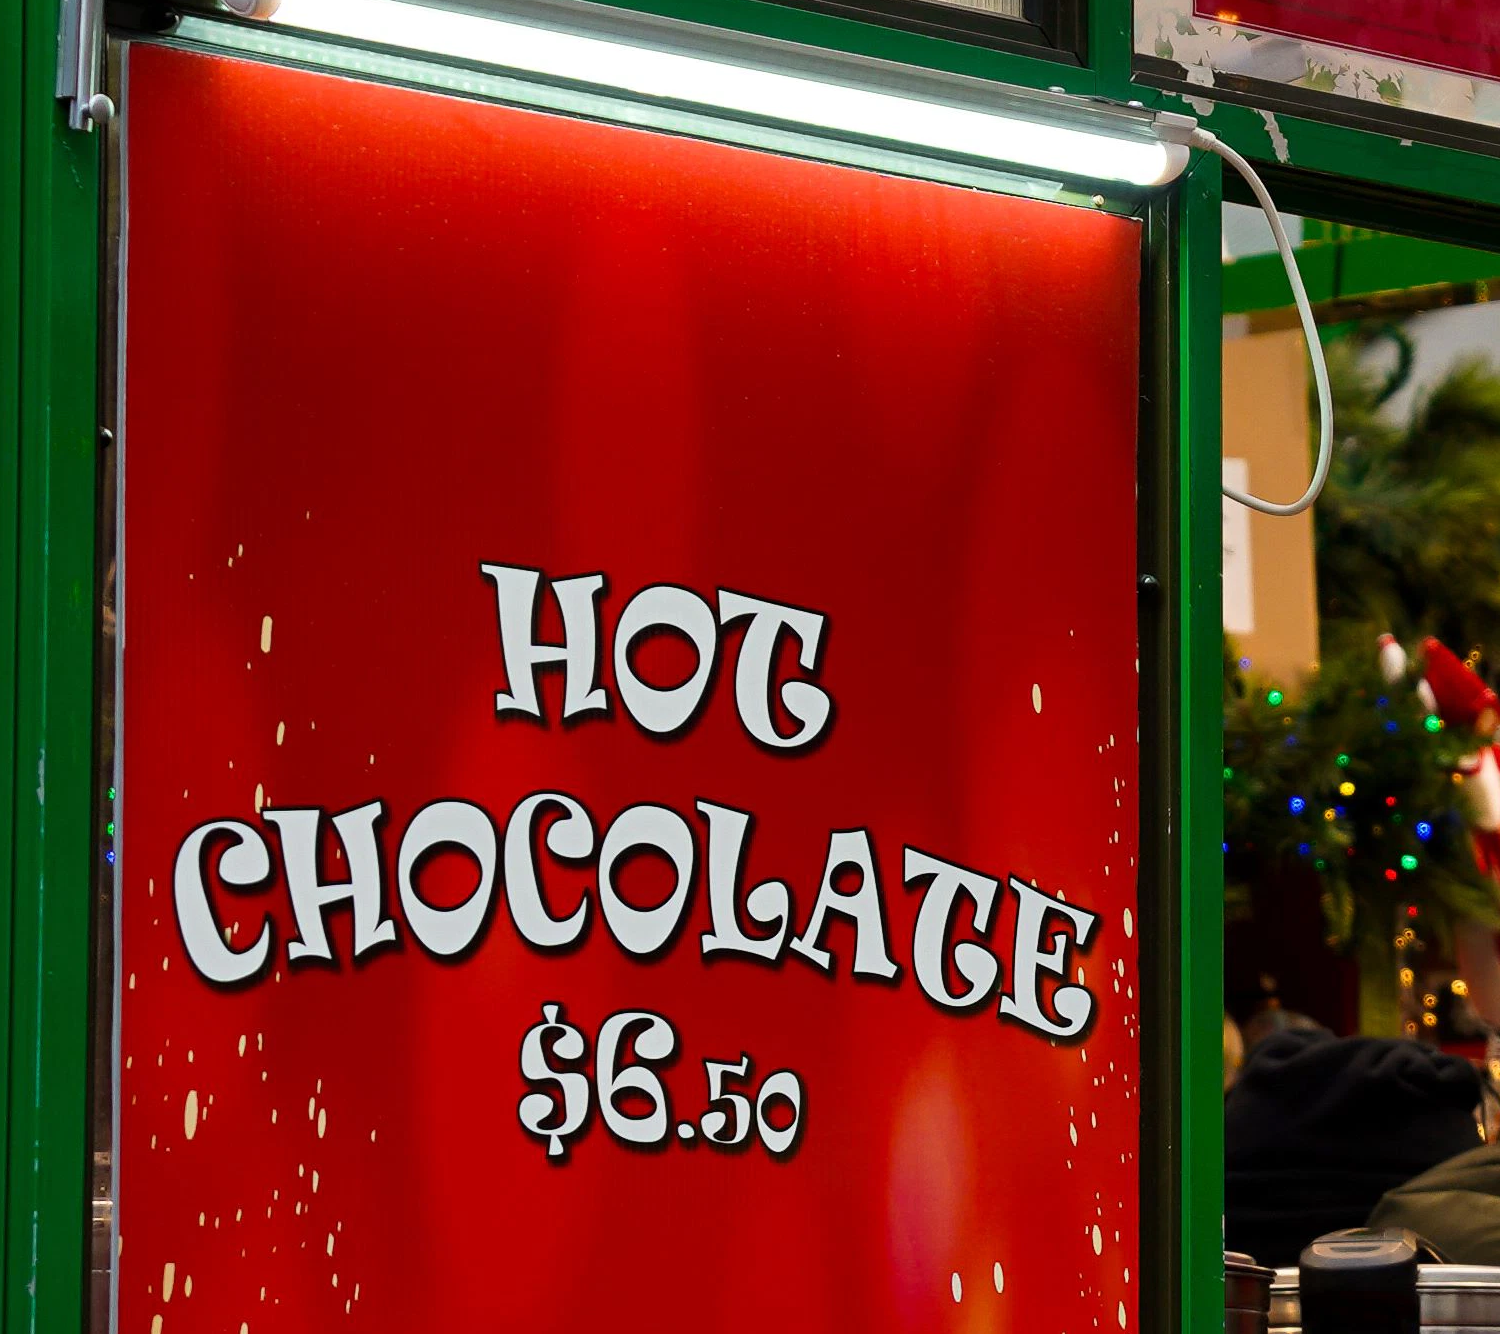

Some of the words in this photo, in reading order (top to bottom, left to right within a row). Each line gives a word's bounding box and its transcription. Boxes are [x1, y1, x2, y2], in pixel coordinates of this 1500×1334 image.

[481, 563, 830, 748] HOT
[174, 793, 1095, 1038] CHOCOLATE
[518, 1004, 801, 1156] $6.50
